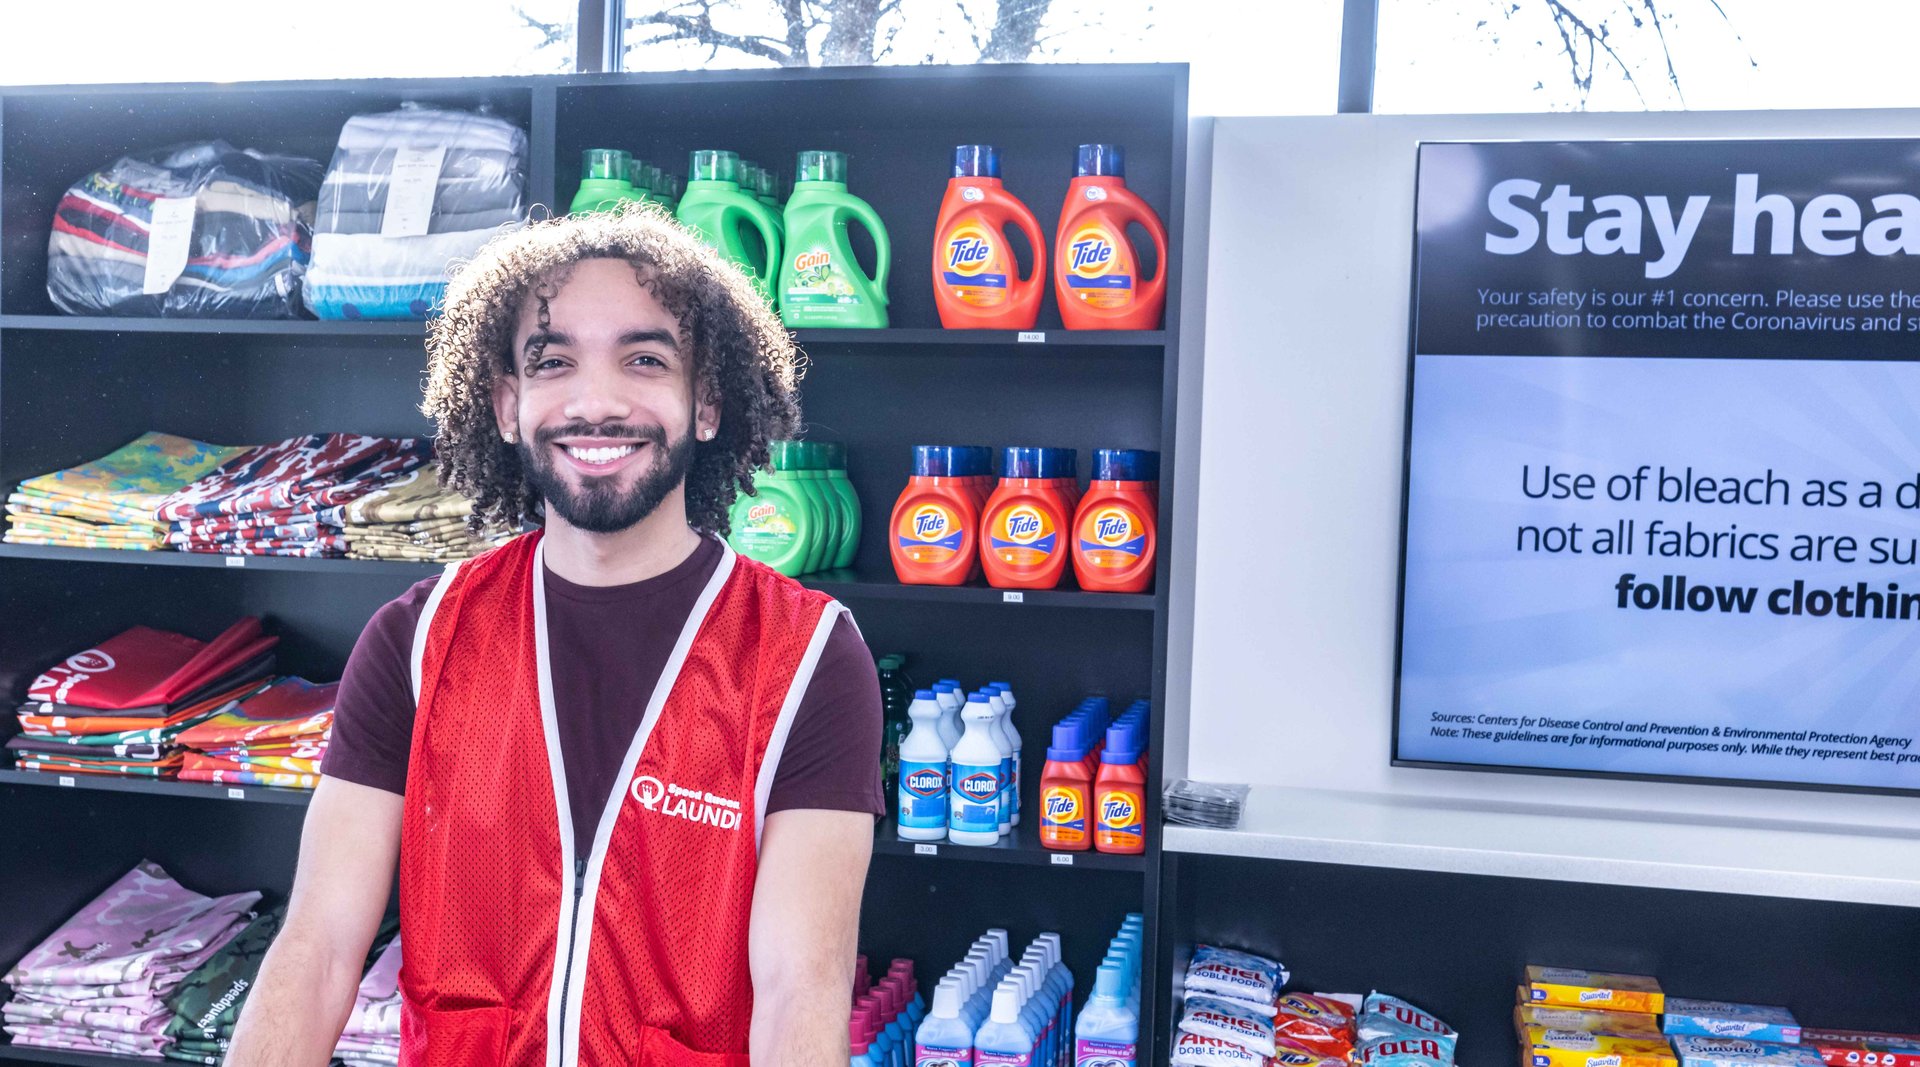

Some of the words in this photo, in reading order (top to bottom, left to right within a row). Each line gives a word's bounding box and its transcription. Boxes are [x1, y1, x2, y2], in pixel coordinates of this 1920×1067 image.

[1485, 179, 1711, 279] Stay
[1732, 174, 1920, 256] hea
[795, 251, 830, 271] Gain
[950, 240, 989, 267] Tide
[1072, 241, 1112, 270] Tide
[1478, 288, 1523, 305] Your
[1528, 288, 1587, 311] safety
[1592, 289, 1606, 306] is
[1612, 292, 1646, 306] our
[1651, 290, 1675, 306] #1
[1682, 292, 1769, 308] concern.
[1776, 290, 1841, 308] Please
[1848, 293, 1884, 308] use
[1891, 291, 1920, 309] the
[1476, 310, 1581, 332] precaution
[1587, 313, 1606, 328] to
[1612, 311, 1688, 329] combat
[1693, 312, 1726, 330] the
[1732, 312, 1856, 331] Coronavirus
[1861, 313, 1901, 332] and
[1521, 465, 1596, 500] Use
[1606, 465, 1651, 502] of
[1658, 467, 1790, 506] bleach
[1801, 477, 1848, 508] as
[1858, 479, 1883, 509] a
[748, 504, 776, 520] Gain
[915, 514, 945, 536] Tide
[1008, 516, 1040, 538] Tide
[1097, 518, 1128, 540] Tide
[1516, 520, 1583, 554] not
[1592, 520, 1634, 555] all
[1644, 520, 1779, 562] fabrics
[1790, 533, 1858, 563] are
[1869, 536, 1917, 566] su
[1615, 573, 1759, 614] follow
[1430, 711, 1476, 724] Sources:
[1478, 714, 1518, 727] Centers
[1519, 716, 1536, 730] for
[1538, 717, 1580, 730] Disease
[1582, 719, 1623, 732] Control
[1625, 721, 1648, 733] and
[1650, 723, 1709, 737] Prevention
[1712, 727, 1720, 737] &
[1724, 727, 1807, 742] Environmental
[1808, 731, 1868, 745] Protection
[1870, 734, 1912, 749] Agency
[1430, 727, 1460, 738] Note:
[1462, 728, 1492, 740] These
[1494, 730, 1548, 743] guidelines
[1550, 735, 1568, 744] are
[1570, 734, 1588, 748] for
[1590, 734, 1666, 750] informational
[1666, 740, 1720, 752] purposes
[1721, 742, 1748, 756] only.
[1750, 744, 1782, 756] While
[1784, 746, 1810, 759] they
[1812, 748, 1868, 761] represent
[1870, 750, 1894, 762] best
[667, 783, 702, 800] Speed
[910, 776, 943, 789] CLOROX
[964, 780, 997, 793] CLOROX
[1048, 798, 1074, 817] Tide
[1104, 802, 1132, 821] Tide
[1194, 970, 1228, 982] DOBLE
[1230, 976, 1266, 989] PODER
[1196, 964, 1267, 985] ARIEL
[1580, 991, 1611, 1002] Suavitel
[1192, 1017, 1228, 1029] DOBLE
[1230, 1026, 1266, 1039] PODER
[1193, 1012, 1266, 1034] ARIEL
[1715, 1024, 1746, 1034] Suavitel
[1364, 1040, 1440, 1064] FOCA
[1588, 1057, 1620, 1067] Suavitel
